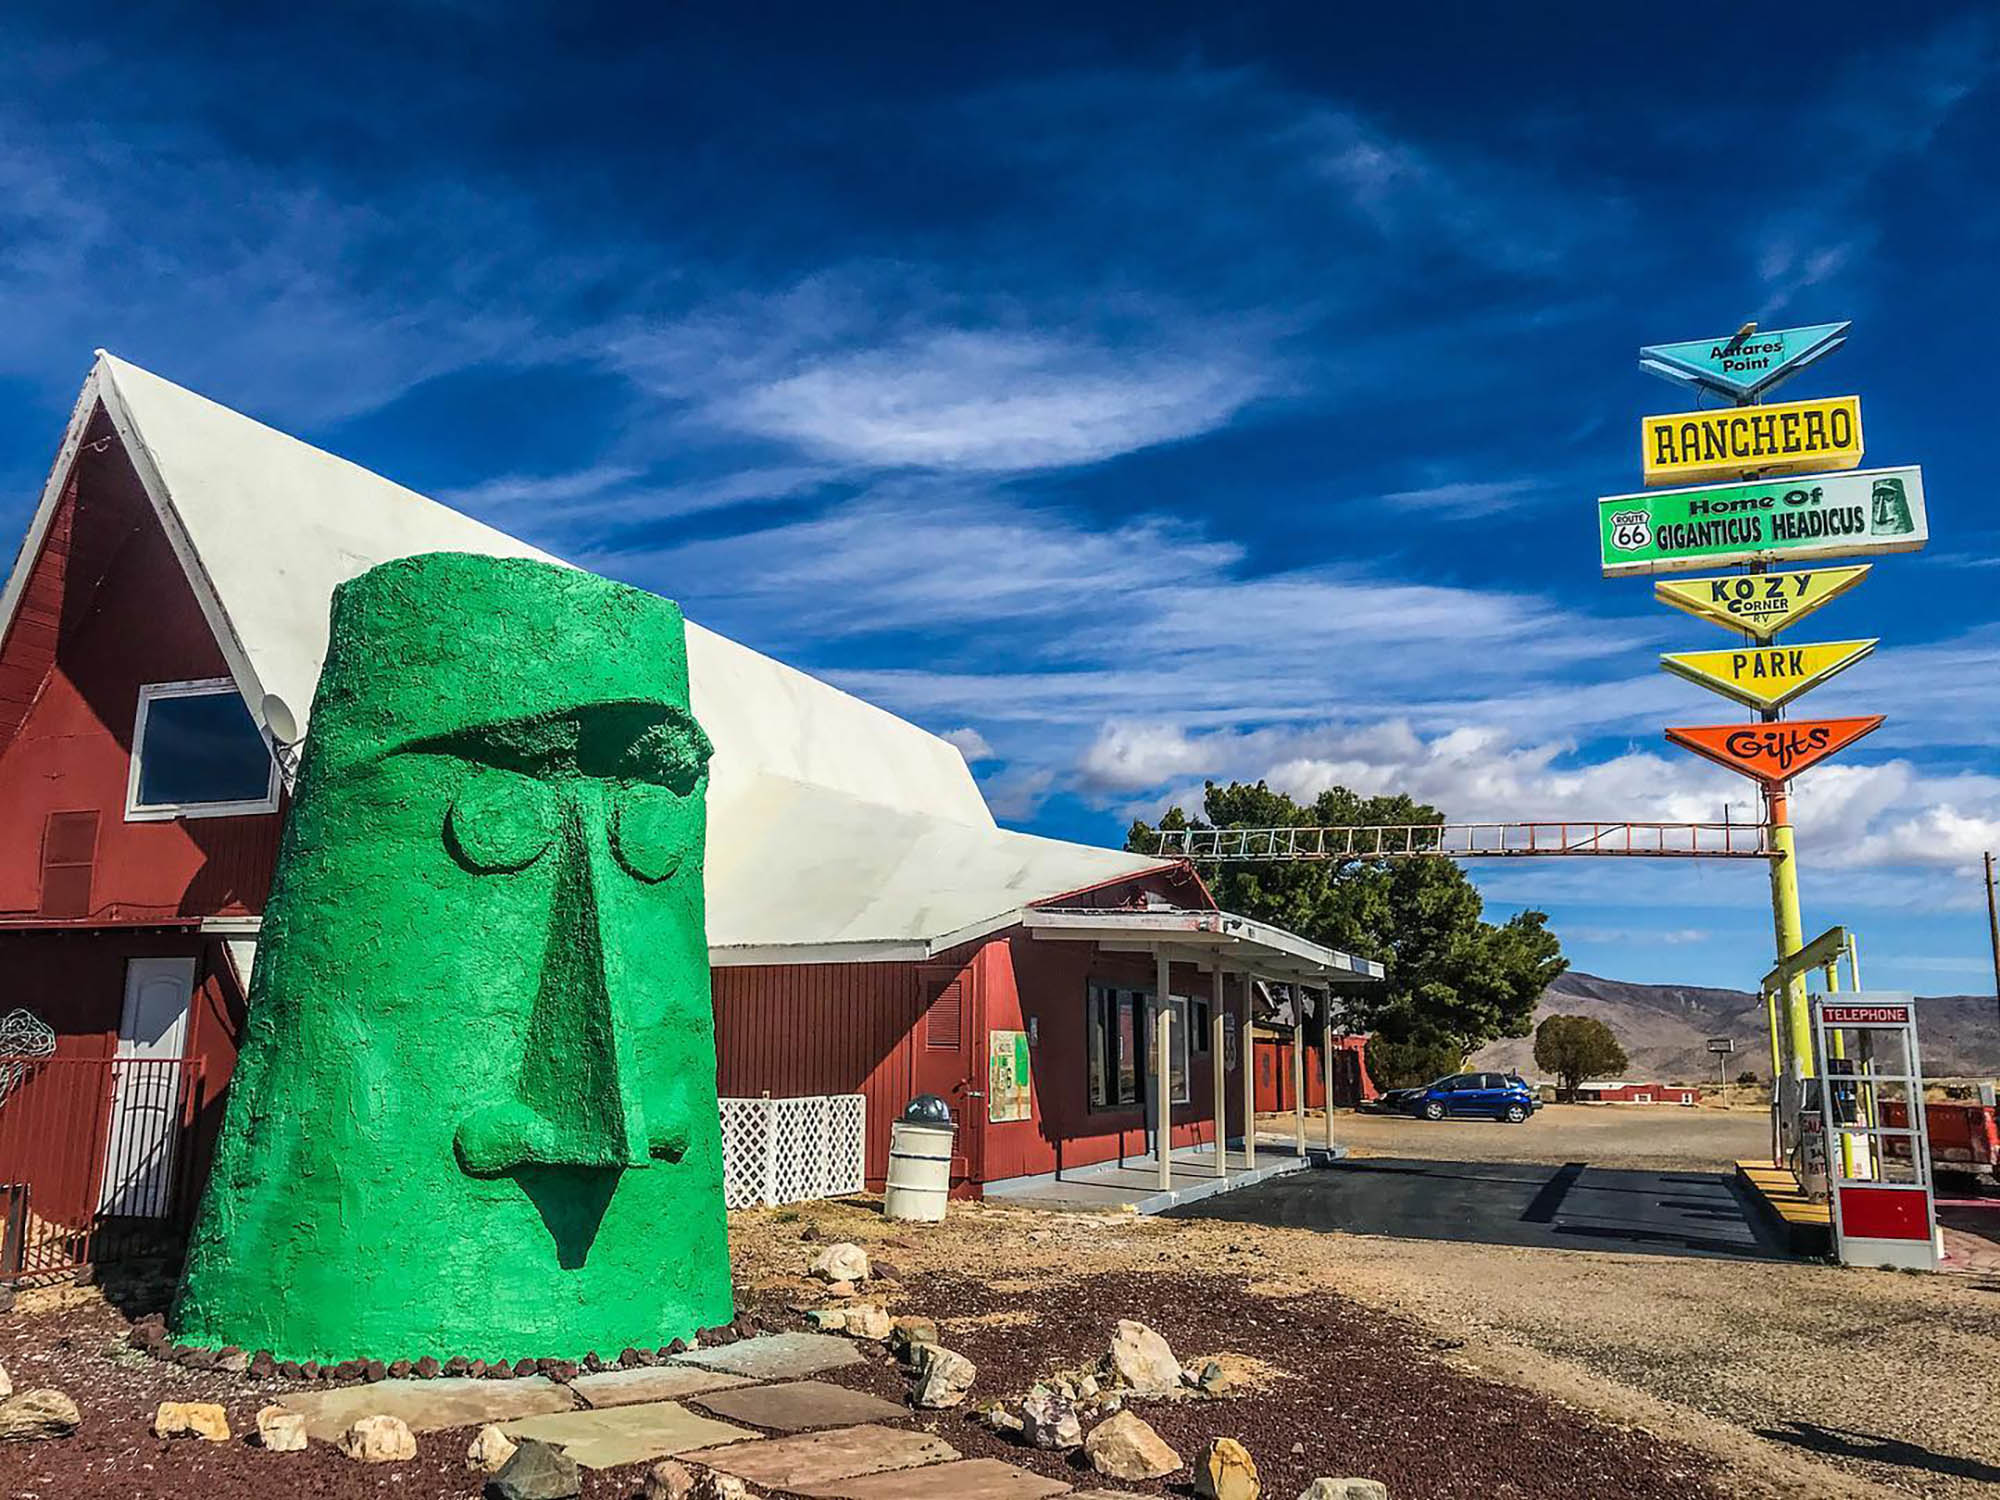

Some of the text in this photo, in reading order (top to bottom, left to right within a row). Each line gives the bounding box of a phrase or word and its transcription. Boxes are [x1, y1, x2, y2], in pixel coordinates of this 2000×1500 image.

[1723, 357, 1769, 372] Point
[1655, 408, 1852, 464] RANCHERO
[1689, 487, 1823, 516] Home Of
[1616, 513, 1644, 523] ROUTE
[1619, 526, 1645, 545] 66
[1656, 506, 1865, 551] GIGANTICUS HEADICUS
[1711, 574, 1811, 602] KOZY
[1727, 598, 1788, 614] CORNER
[1753, 614, 1770, 624] RV
[1733, 650, 1804, 679] PARK
[1825, 1008, 1906, 1021] TELEPHONE
